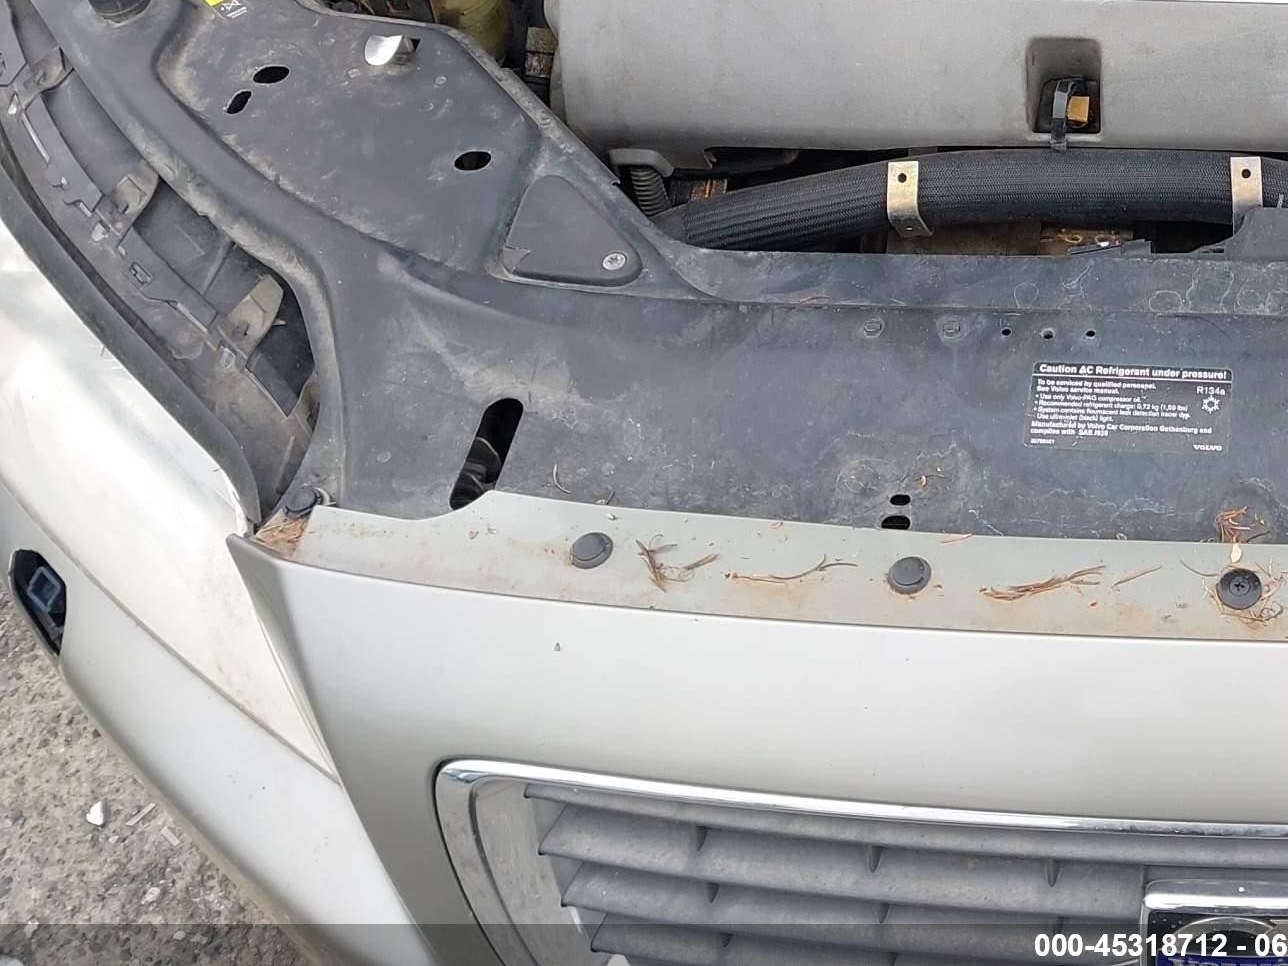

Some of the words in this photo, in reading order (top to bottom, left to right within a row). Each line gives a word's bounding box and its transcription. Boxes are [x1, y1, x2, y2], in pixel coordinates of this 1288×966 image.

[1039, 364, 1077, 374] Caution
[1079, 365, 1094, 374] AC
[1095, 366, 1150, 376] Refrigerant
[1151, 369, 1180, 377] under
[1182, 370, 1227, 380] pressure!
[1093, 380, 1121, 388] qualified
[1196, 386, 1226, 395] R134a
[1098, 395, 1132, 403] compressor
[1083, 401, 1113, 409] refrigerant
[1031, 421, 1076, 429] Manufactured
[1119, 424, 1158, 432] Corporation
